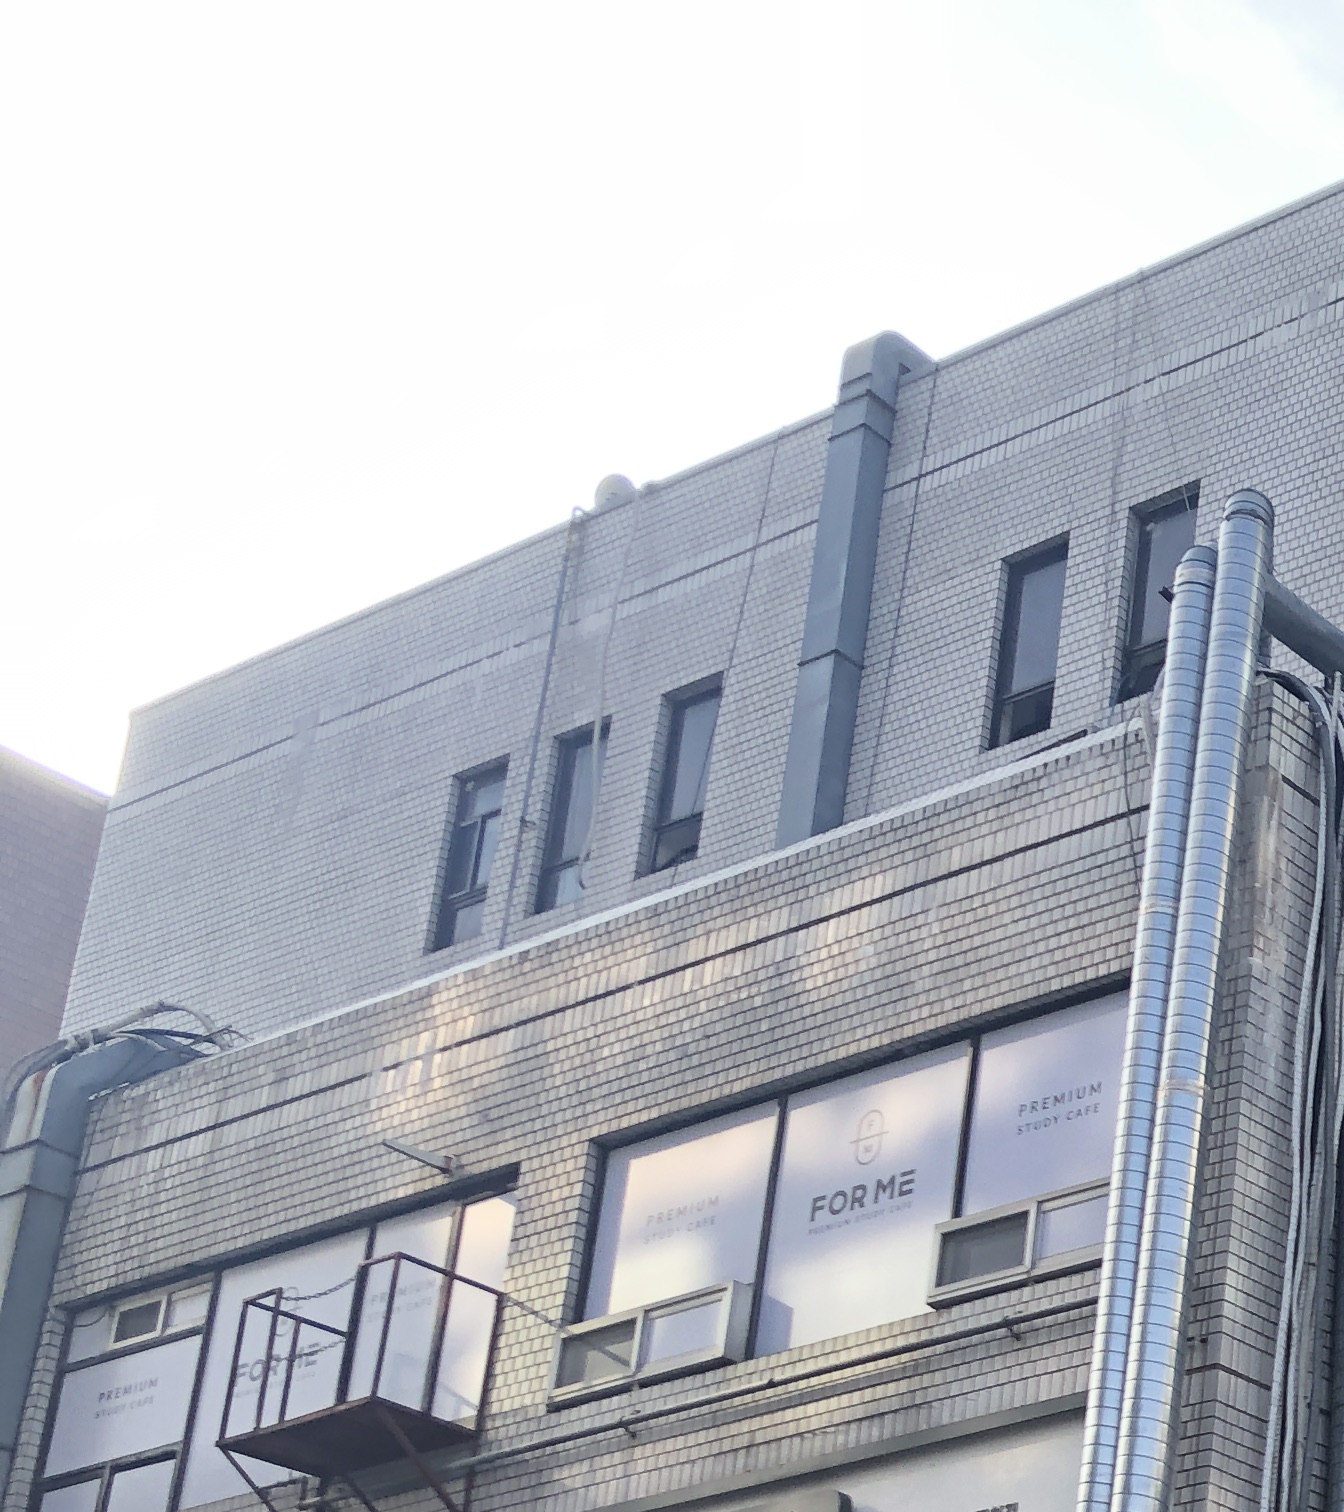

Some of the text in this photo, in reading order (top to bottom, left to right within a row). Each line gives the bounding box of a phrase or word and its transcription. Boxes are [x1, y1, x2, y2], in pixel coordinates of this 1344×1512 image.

[1016, 1080, 1104, 1119] PREMIUM
[1015, 1101, 1102, 1136] STUDY CAFE
[646, 1194, 721, 1228] PREMIUM
[98, 1377, 158, 1404] PREMIUM
